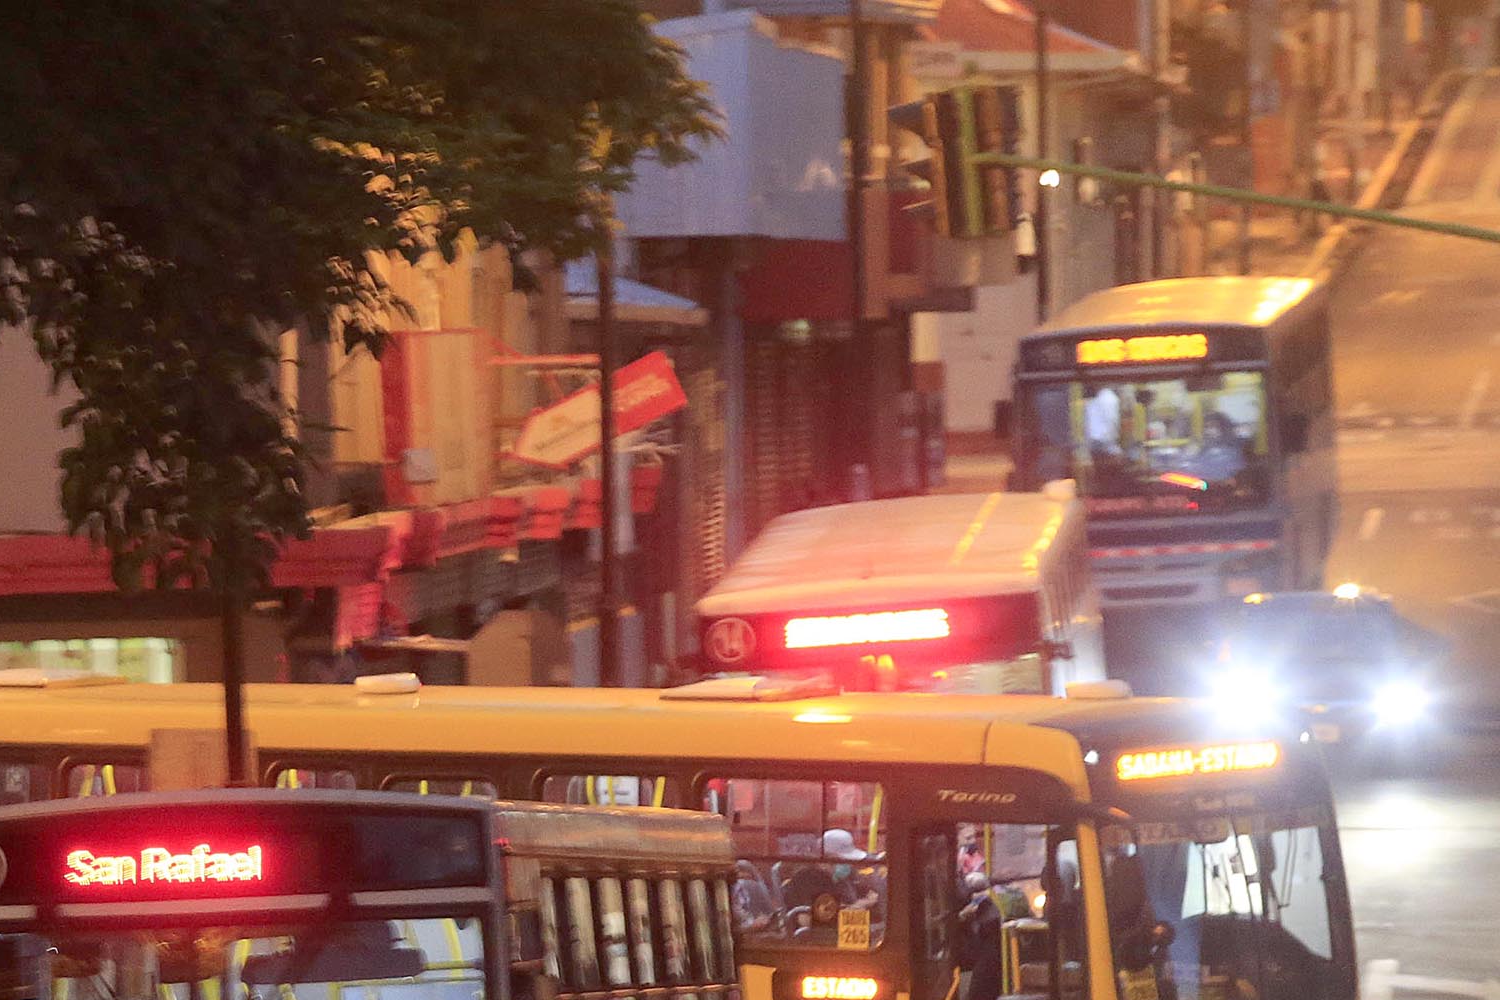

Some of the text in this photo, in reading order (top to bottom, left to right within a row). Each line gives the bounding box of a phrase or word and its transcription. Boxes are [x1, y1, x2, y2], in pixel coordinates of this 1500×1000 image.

[939, 789, 1017, 803] Torino
[64, 844, 262, 885] San Rafael
